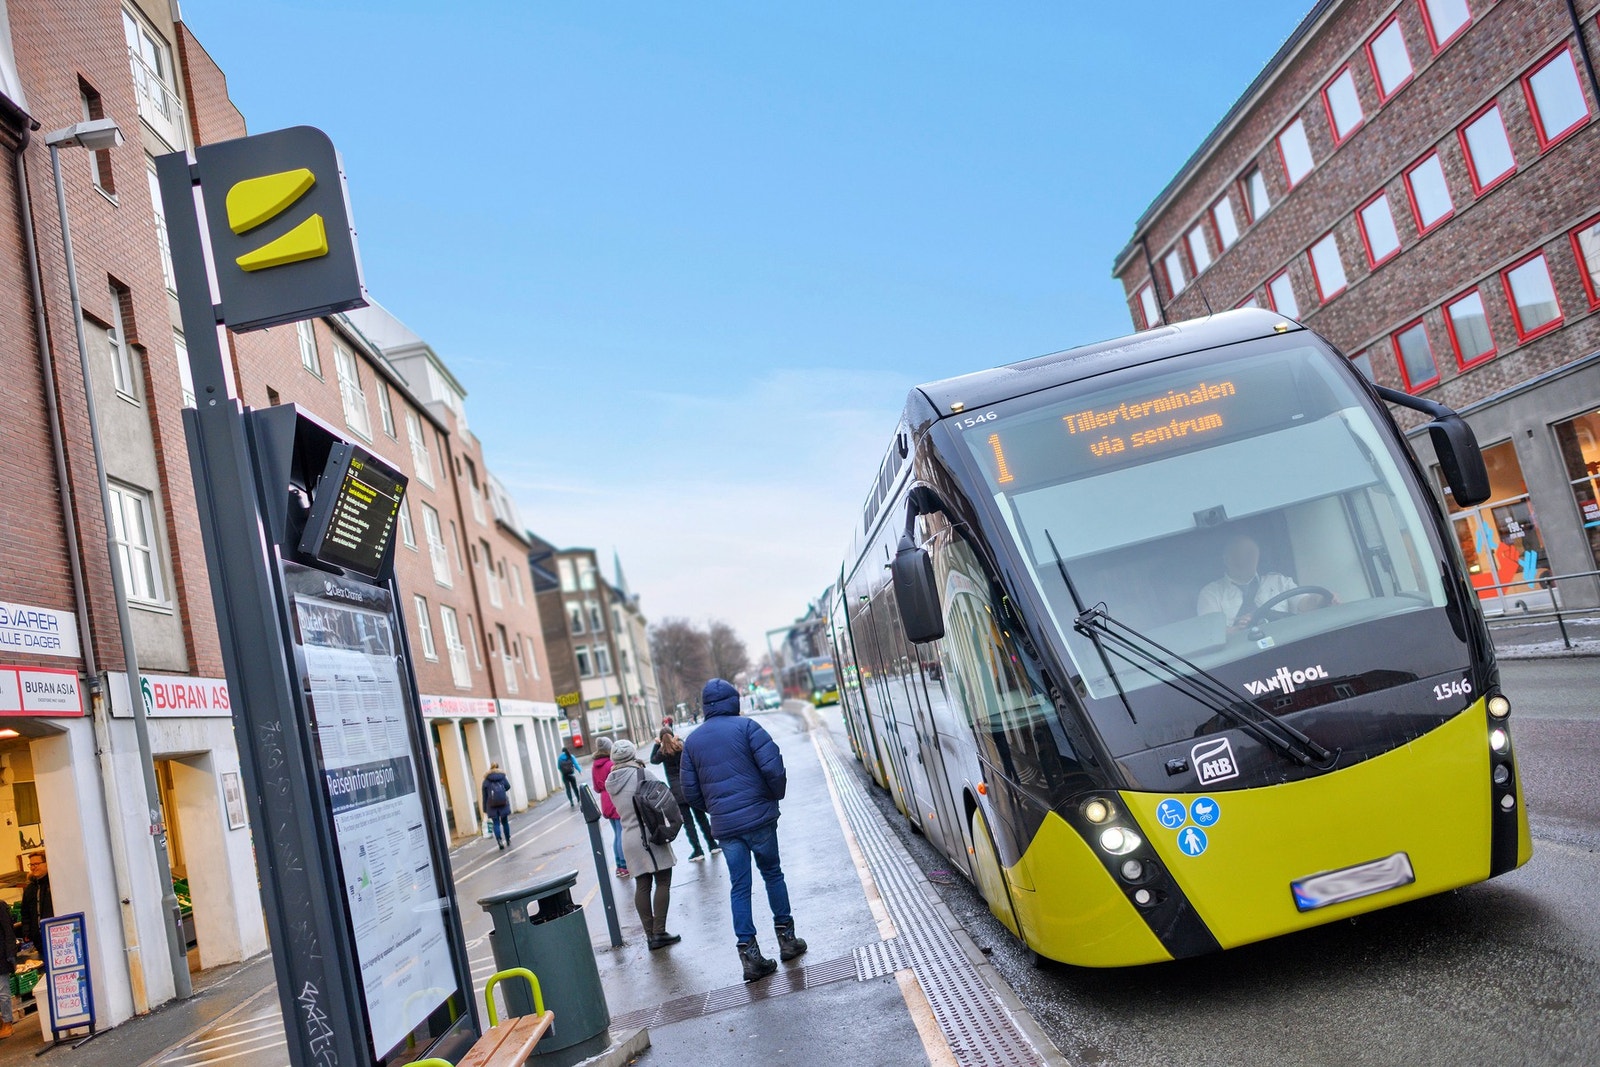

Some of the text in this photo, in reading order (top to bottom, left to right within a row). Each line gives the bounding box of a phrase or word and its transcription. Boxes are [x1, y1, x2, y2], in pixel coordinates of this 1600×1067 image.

[1062, 380, 1236, 434] Tillerterminalen
[954, 411, 997, 430] 1546
[1090, 412, 1223, 457] via sentrum
[988, 433, 1014, 483] 1
[24, 634, 61, 649] DAGER
[25, 681, 76, 695] BURAN ASIA
[153, 683, 208, 709] BURAN
[1433, 678, 1472, 700] 1546
[326, 764, 395, 797] Reiseinformasjon
[1202, 758, 1232, 780] AtB
